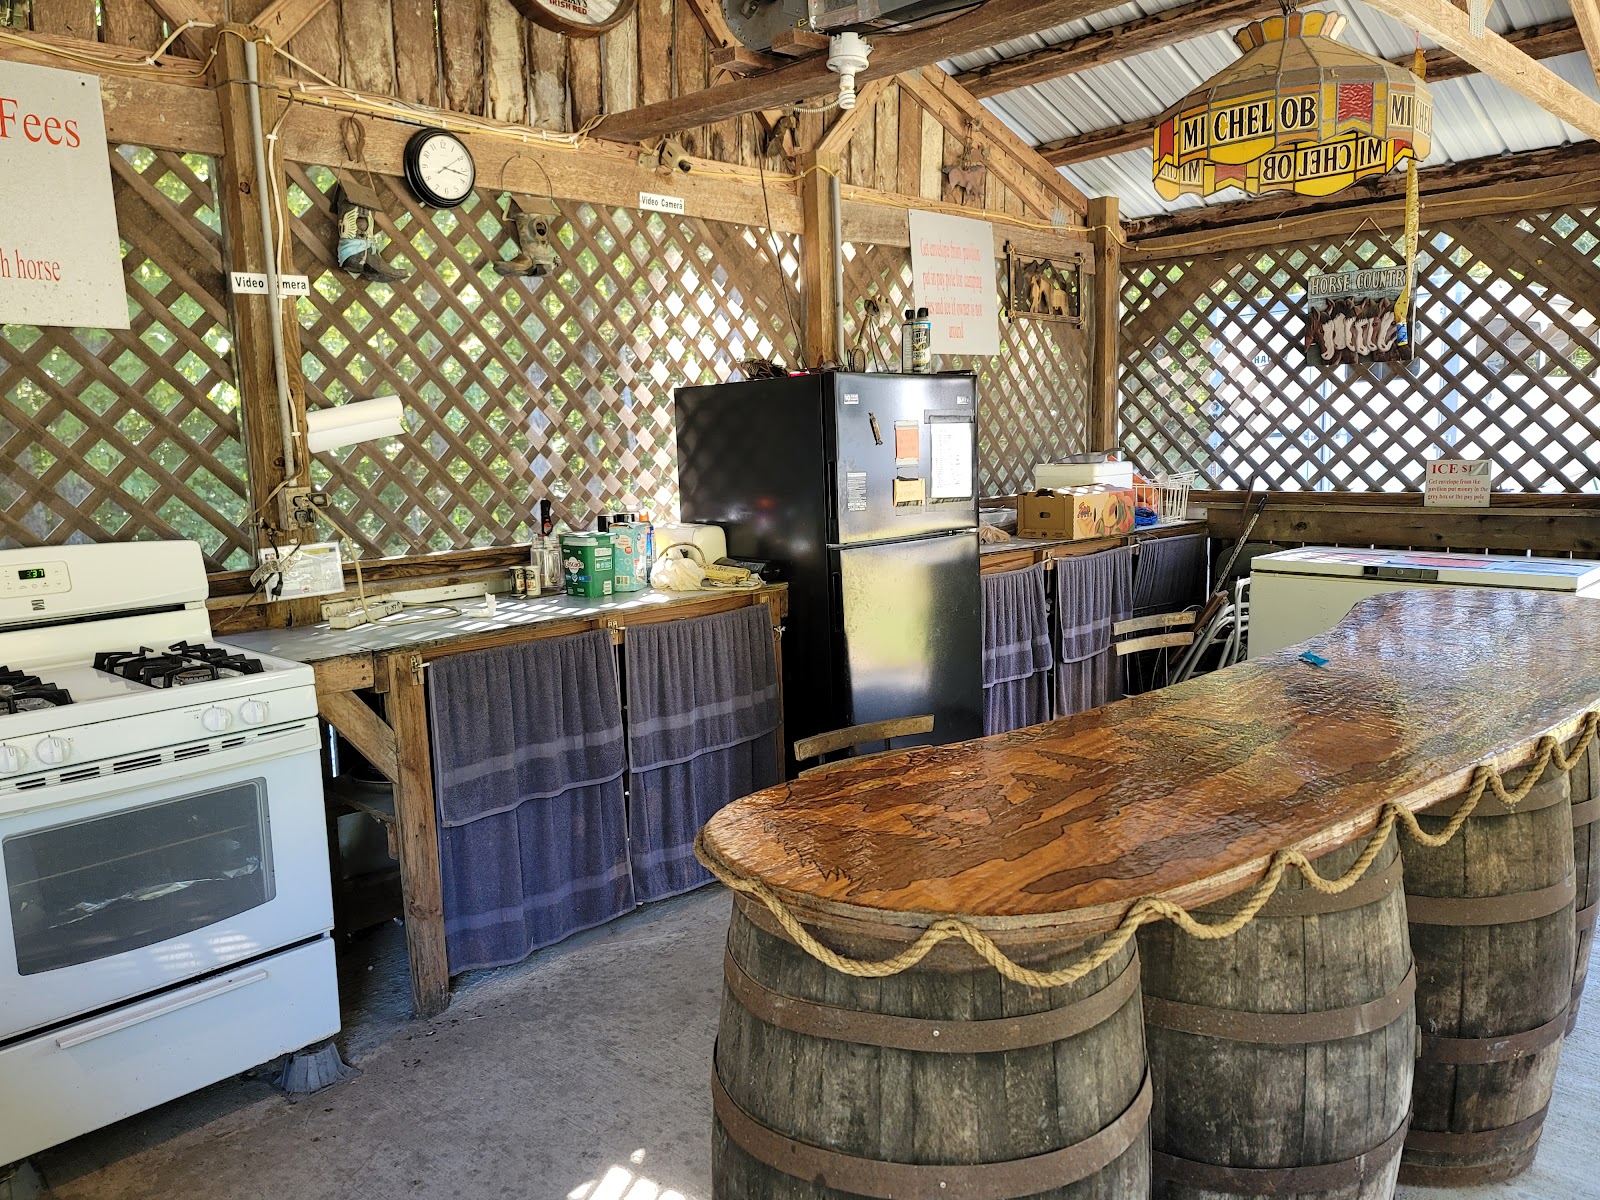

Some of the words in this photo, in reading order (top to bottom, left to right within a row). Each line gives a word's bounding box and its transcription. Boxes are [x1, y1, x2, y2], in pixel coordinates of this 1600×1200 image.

[572, 5, 587, 15] RED
[0, 97, 81, 148] Fees
[641, 195, 659, 206] Video
[661, 198, 683, 210] Camera
[15, 249, 61, 282] horse
[234, 275, 264, 289] Video
[1310, 273, 1351, 296] HORSE
[1356, 268, 1407, 290] COUNTR
[1432, 463, 1459, 475] ICE
[1438, 478, 1459, 486] envelope
